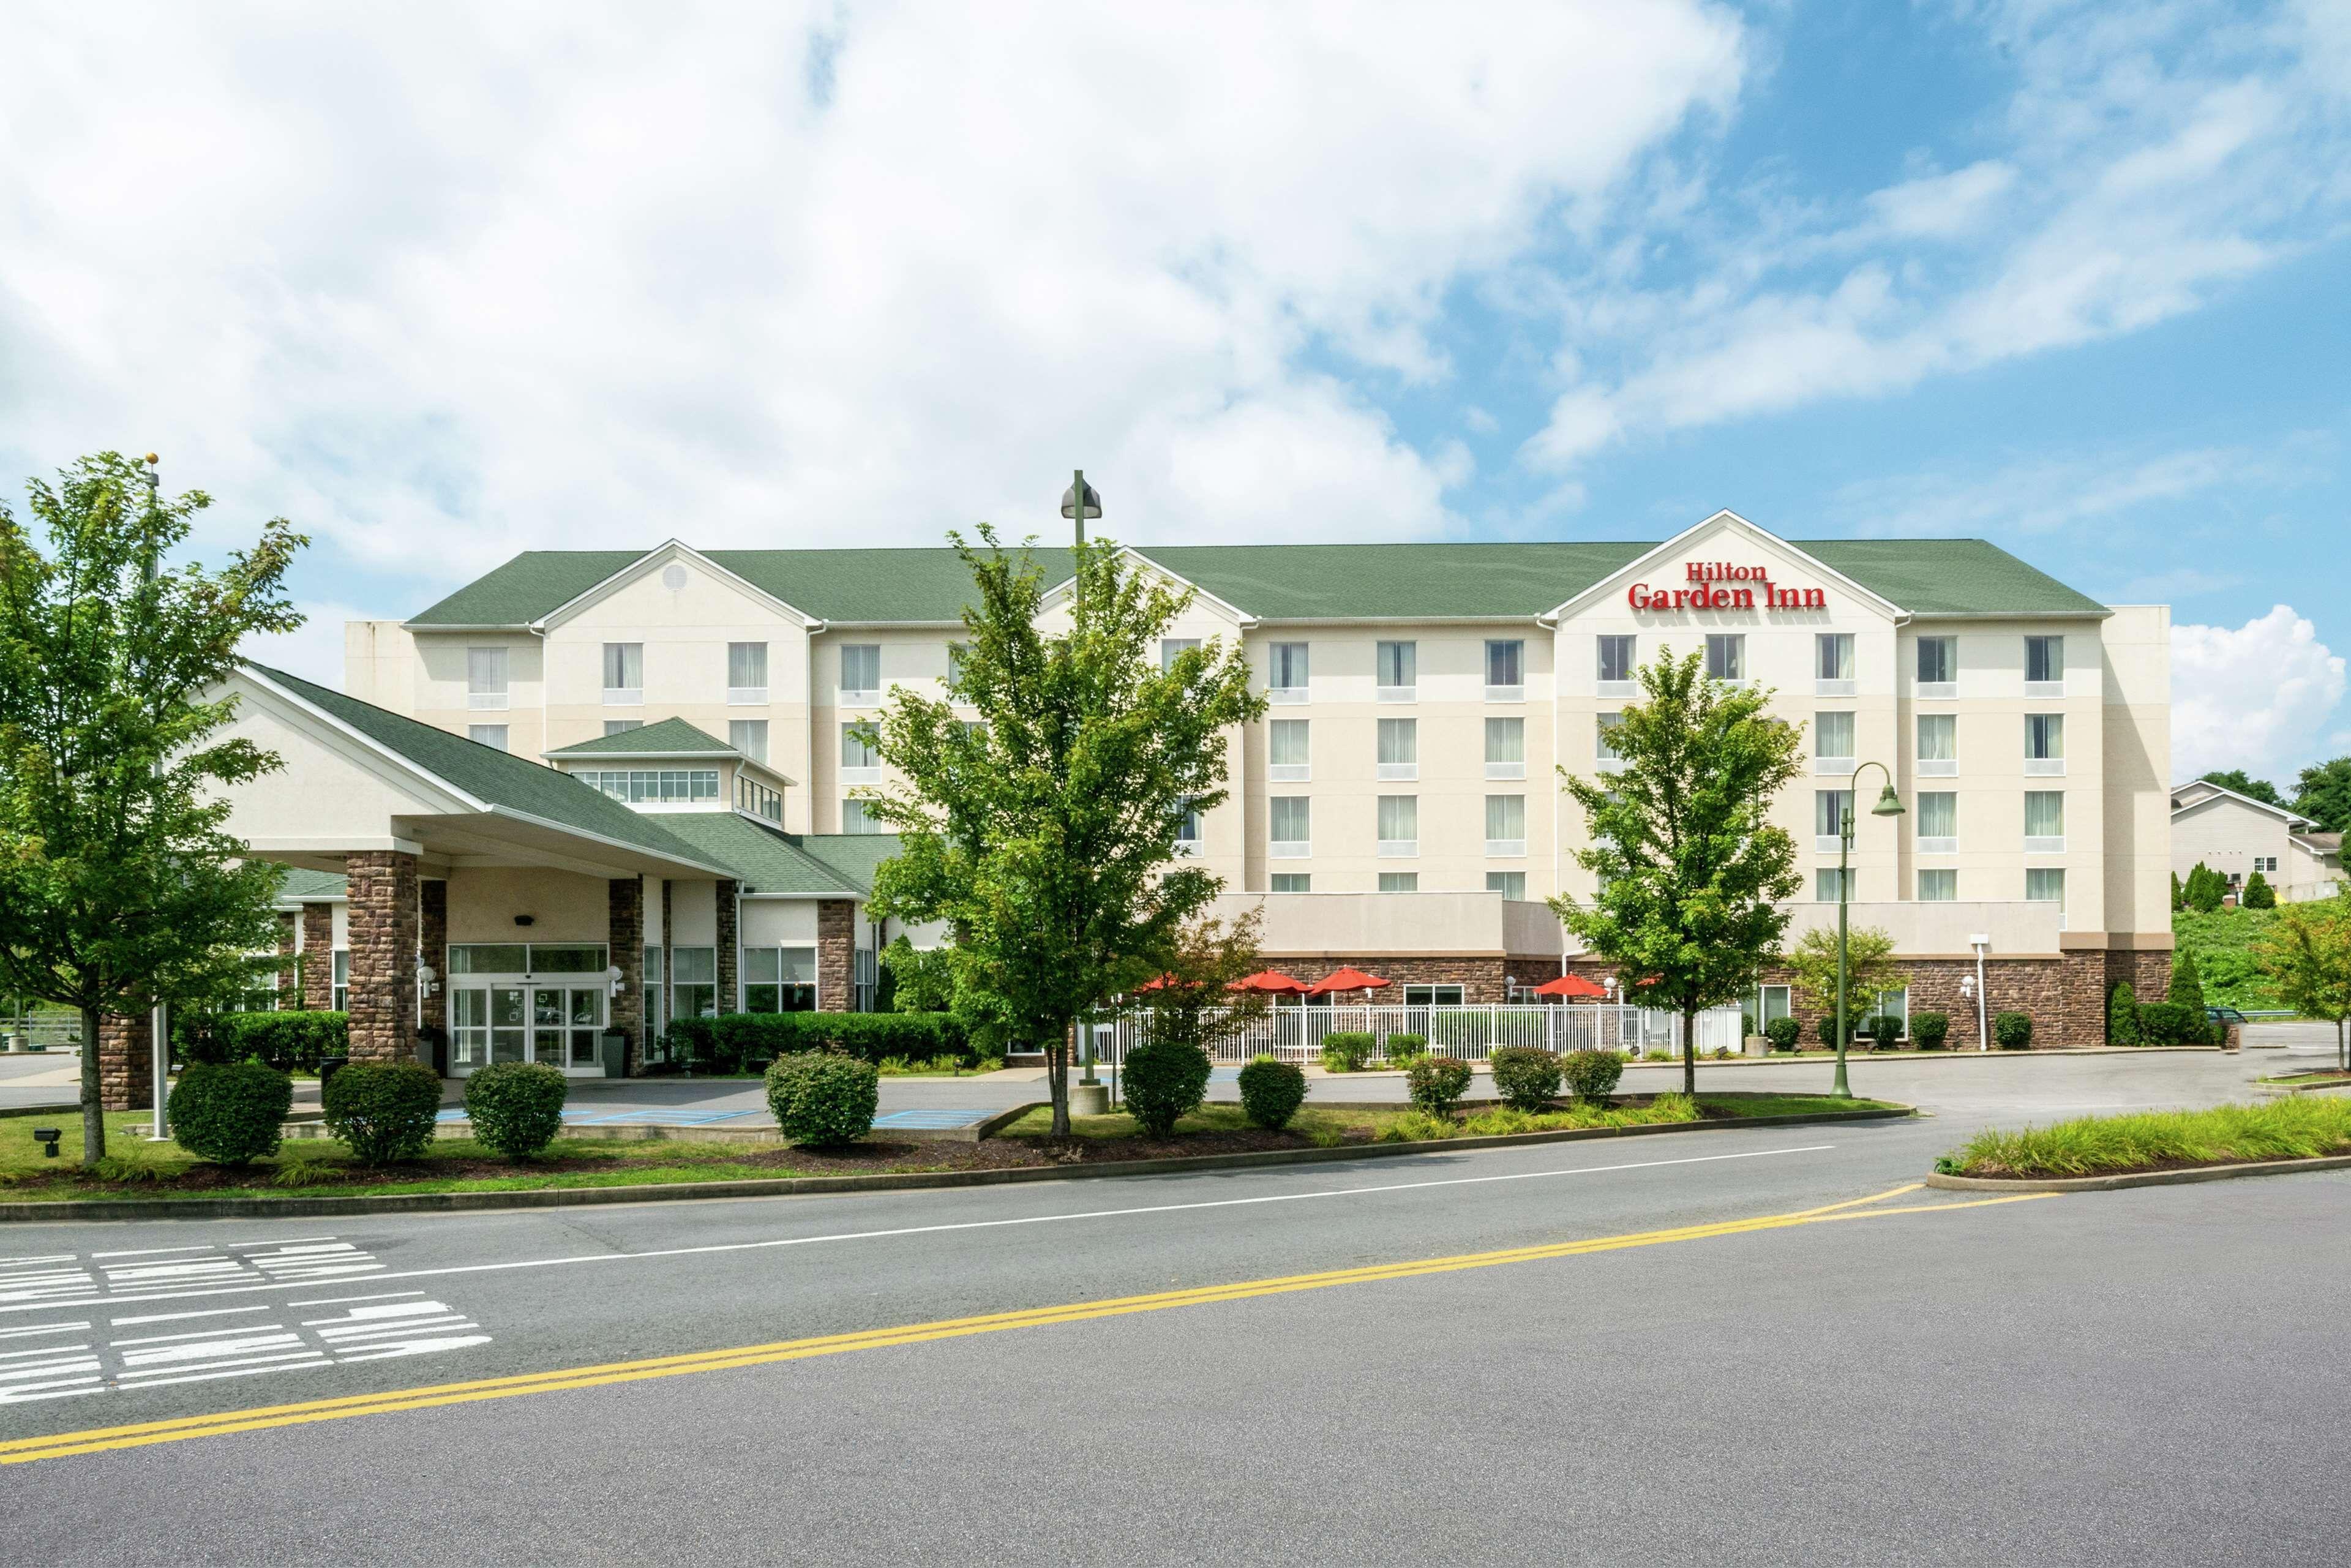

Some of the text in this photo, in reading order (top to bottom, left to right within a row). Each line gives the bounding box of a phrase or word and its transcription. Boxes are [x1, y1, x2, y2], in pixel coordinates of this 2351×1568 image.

[1685, 562, 1768, 581] Hilton
[1628, 582, 1827, 610] Garden Inn
[0, 1291, 493, 1404] ONLY
